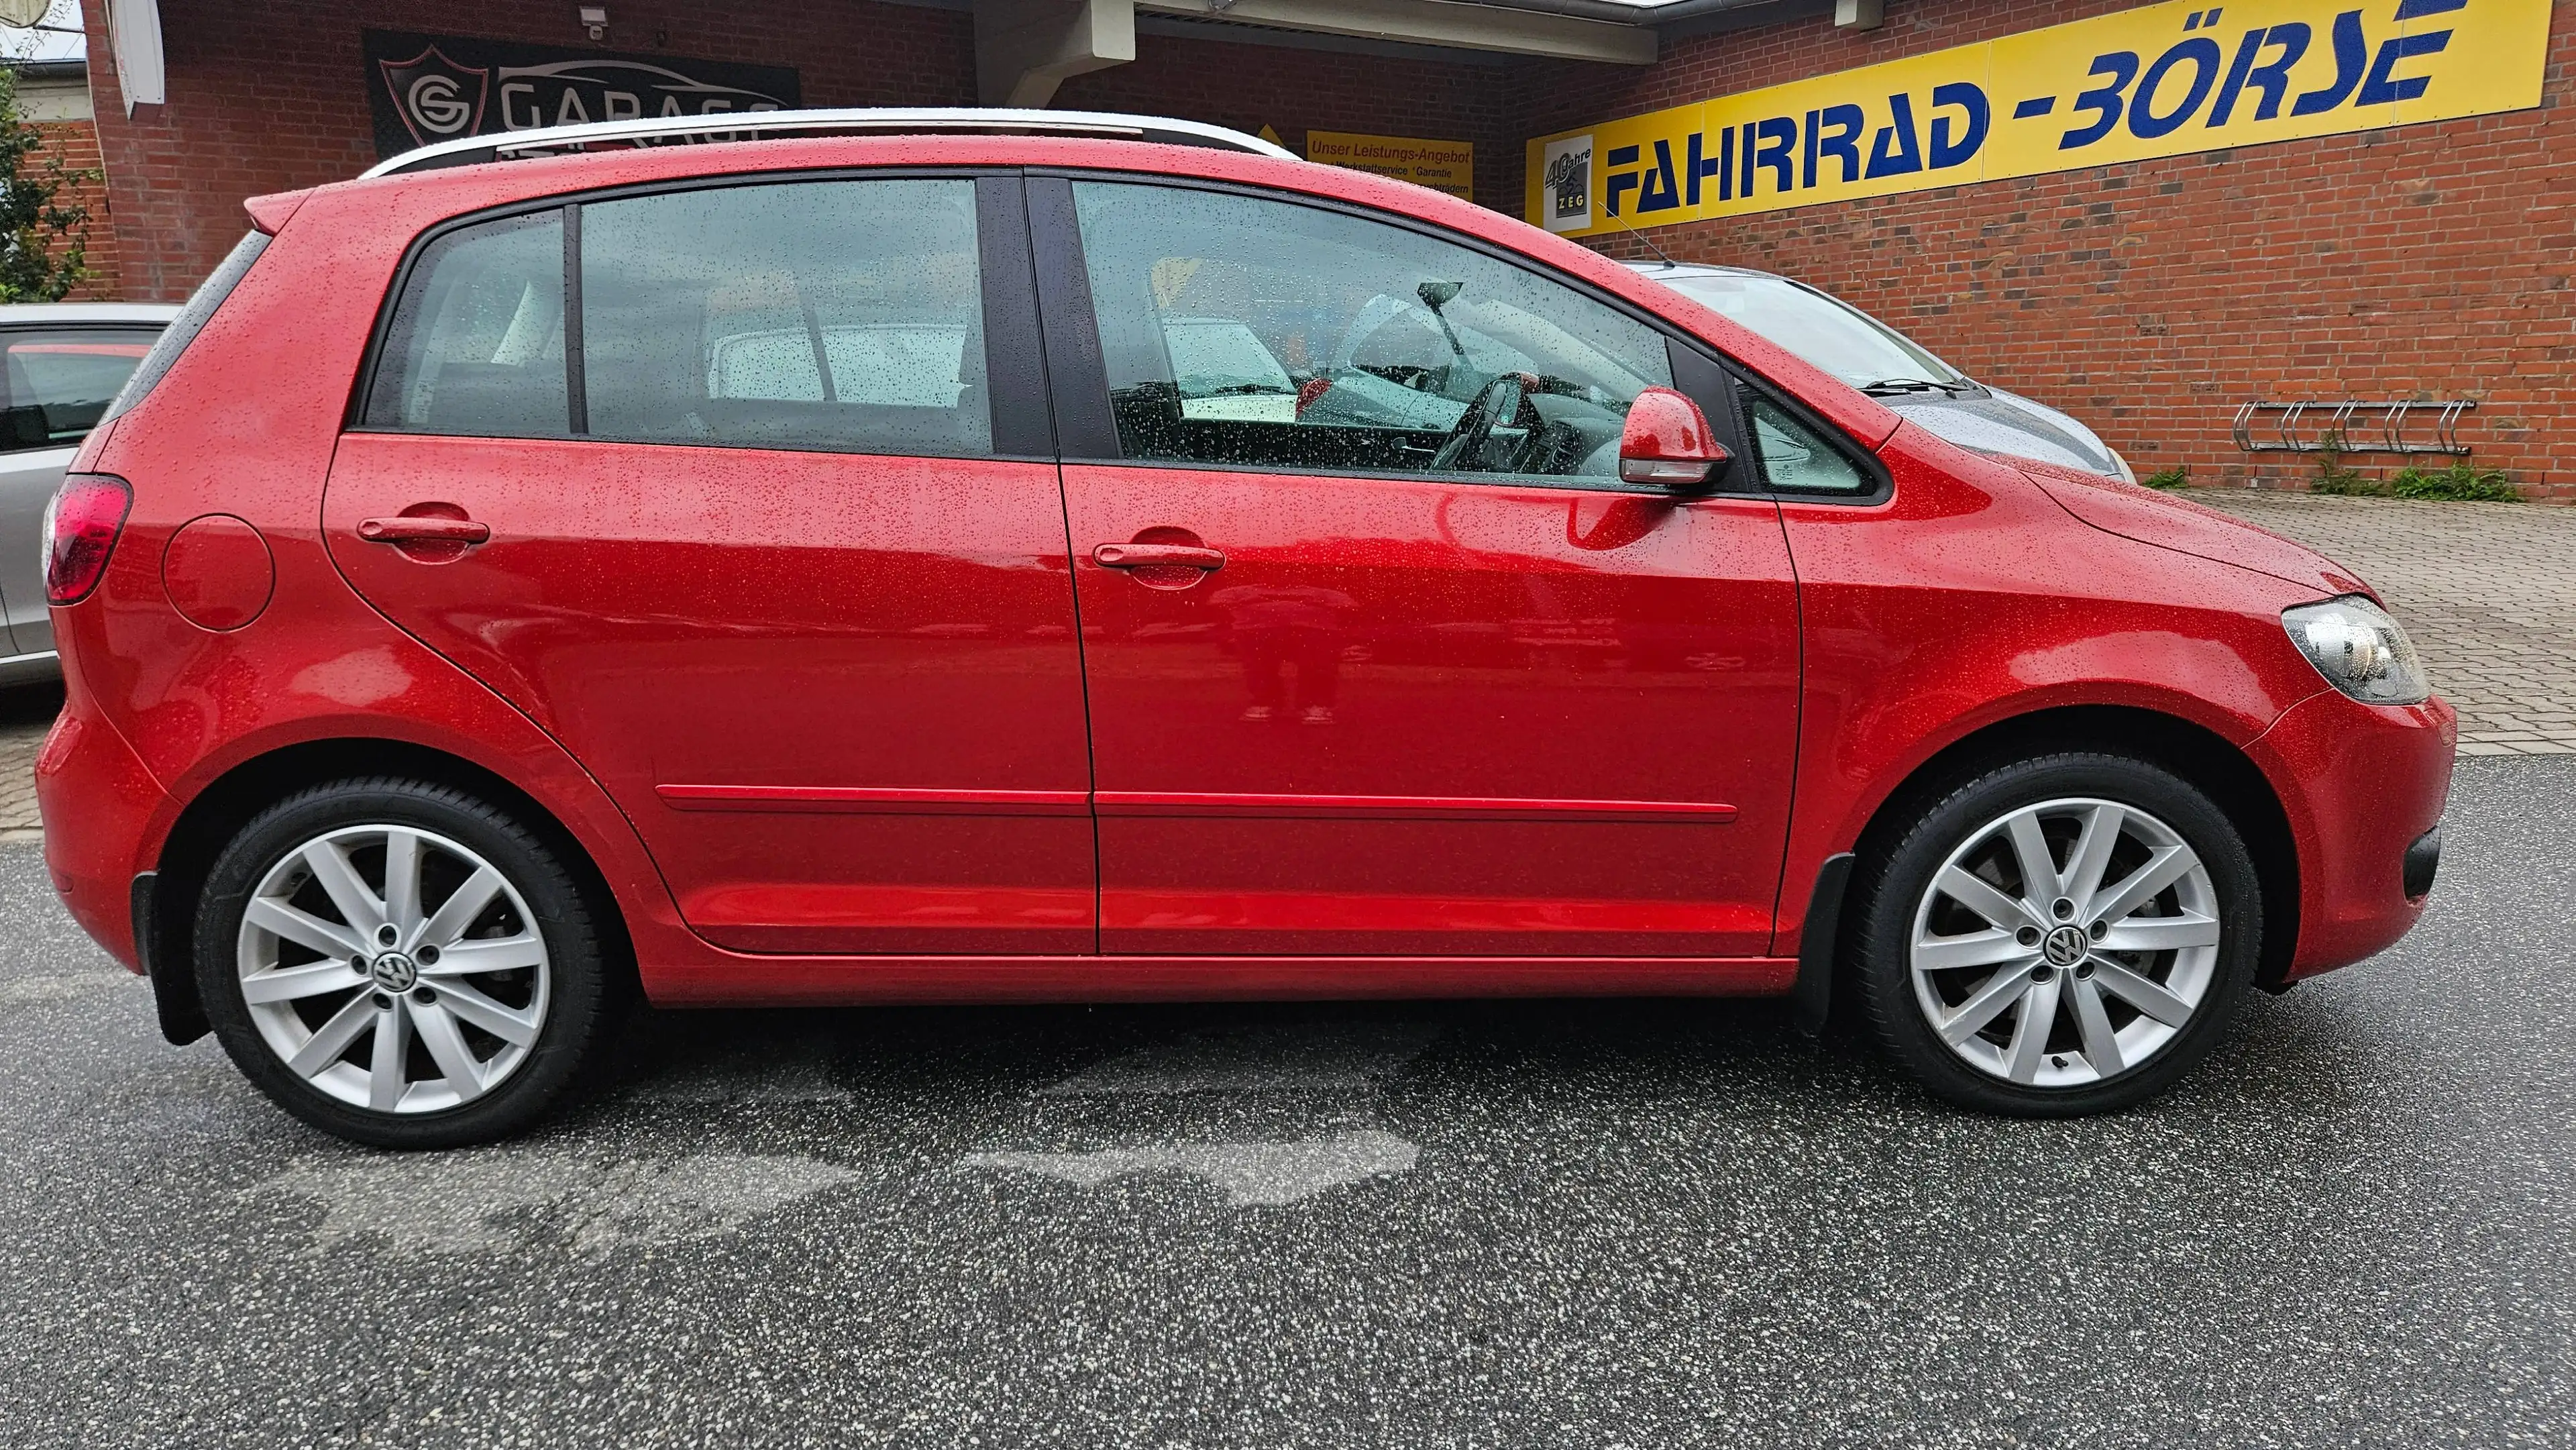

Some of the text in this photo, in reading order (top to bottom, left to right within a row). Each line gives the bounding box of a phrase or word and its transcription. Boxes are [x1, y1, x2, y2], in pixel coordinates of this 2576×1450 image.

[1312, 138, 1469, 164] Unser Leistungs-Angebot
[1416, 166, 1452, 178] Garantie
[1558, 195, 1584, 209] ZEG
